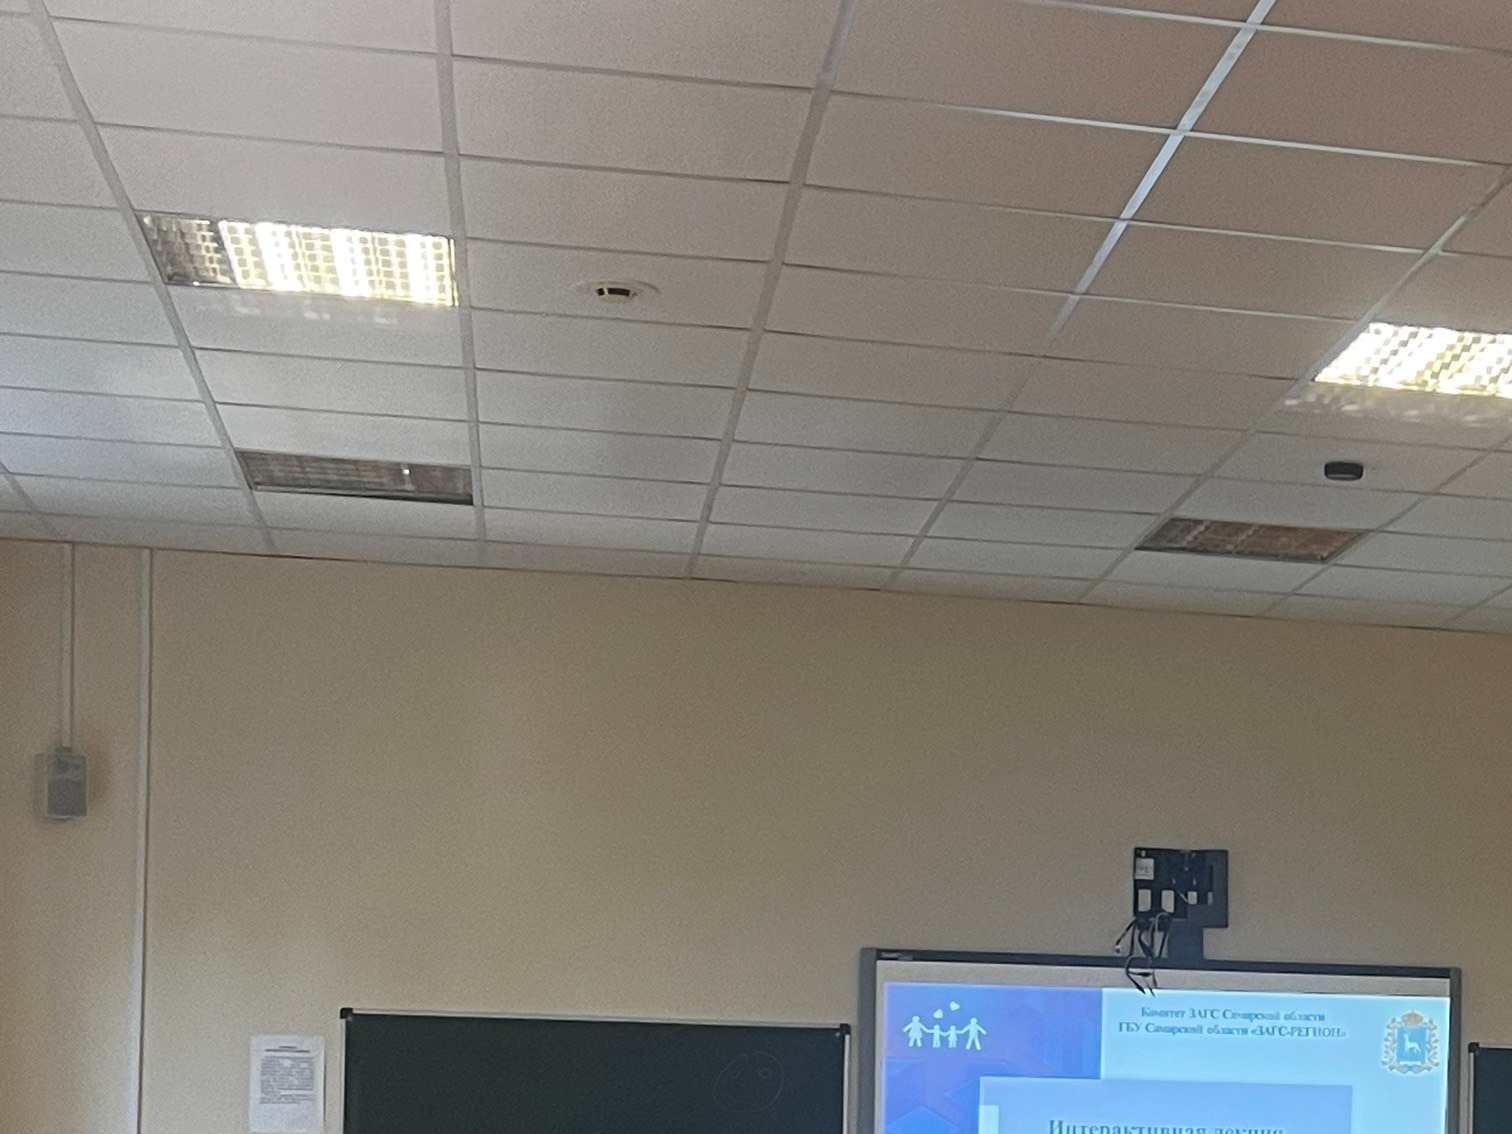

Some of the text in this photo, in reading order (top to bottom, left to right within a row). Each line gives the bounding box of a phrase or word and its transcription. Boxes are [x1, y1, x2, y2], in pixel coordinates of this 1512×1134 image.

[1141, 1006, 1326, 1022] Комитет ЗАГС Самарской области
[1118, 1021, 1140, 1033] ГБУ
[1144, 1022, 1203, 1035] Самарской
[1206, 1024, 1249, 1036] области
